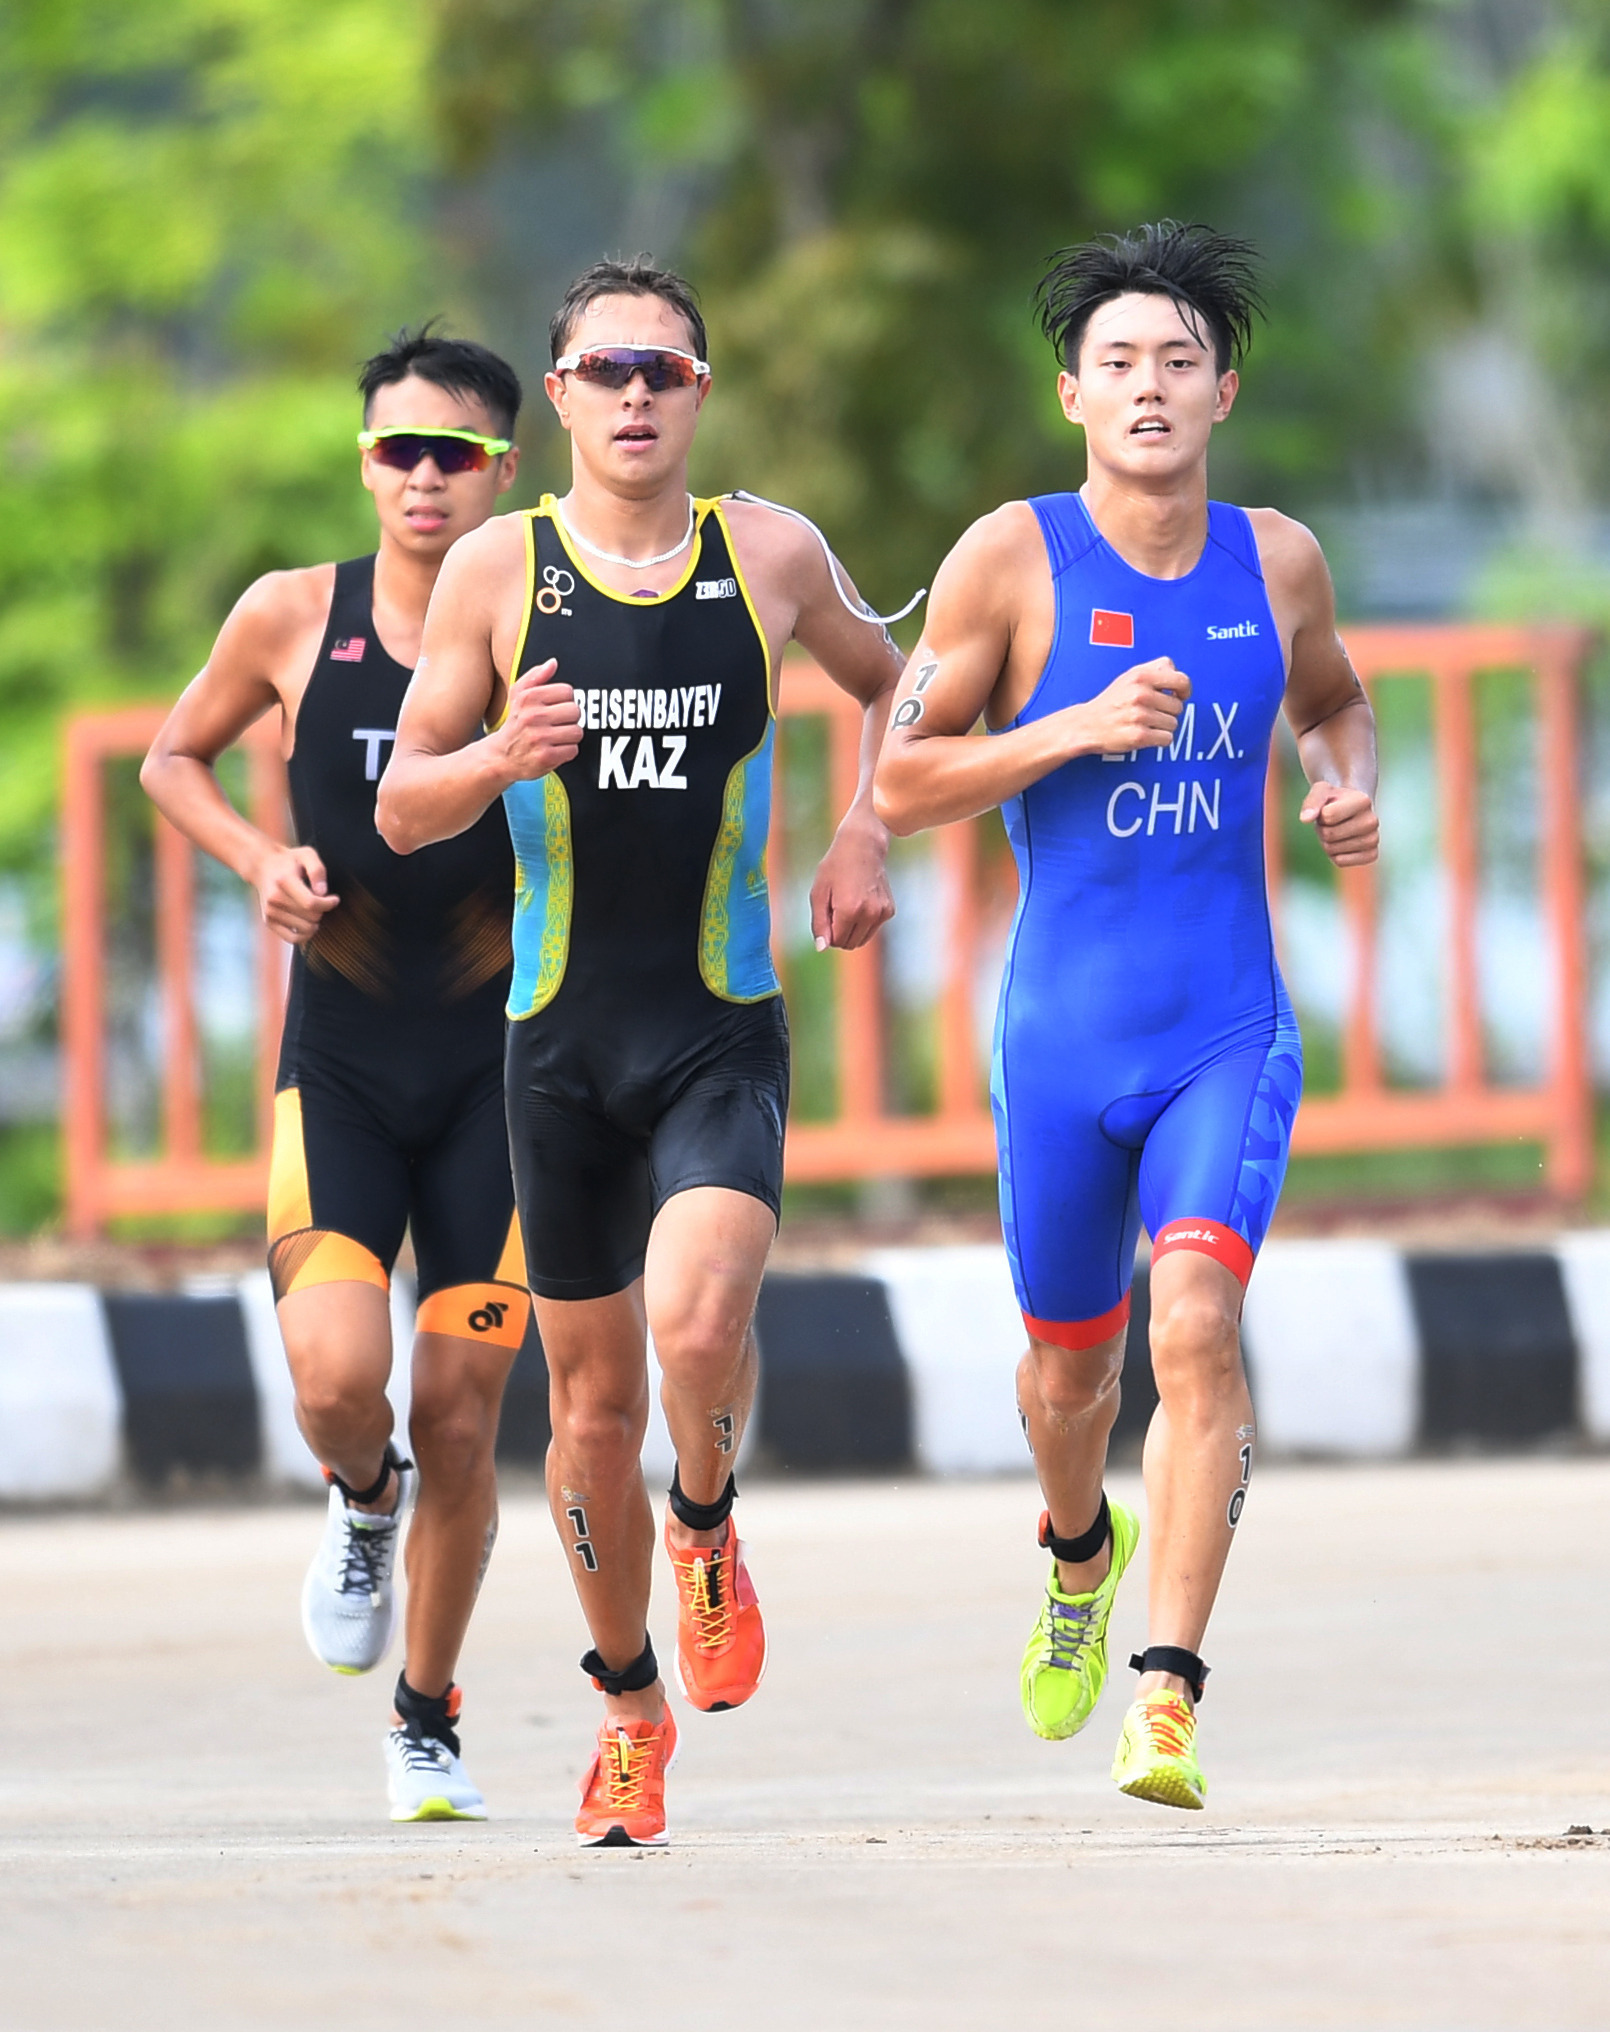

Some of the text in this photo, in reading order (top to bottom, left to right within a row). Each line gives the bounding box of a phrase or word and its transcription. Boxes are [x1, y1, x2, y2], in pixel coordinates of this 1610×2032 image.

[1206, 620, 1260, 641] Santic
[573, 683, 722, 730] BEISENBAYEV
[891, 660, 940, 731] 10
[598, 735, 688, 790] KAZ
[1106, 778, 1221, 838] CHN
[712, 1413, 736, 1455] 11
[1226, 1442, 1253, 1530] 10
[566, 1505, 599, 1573] 11
